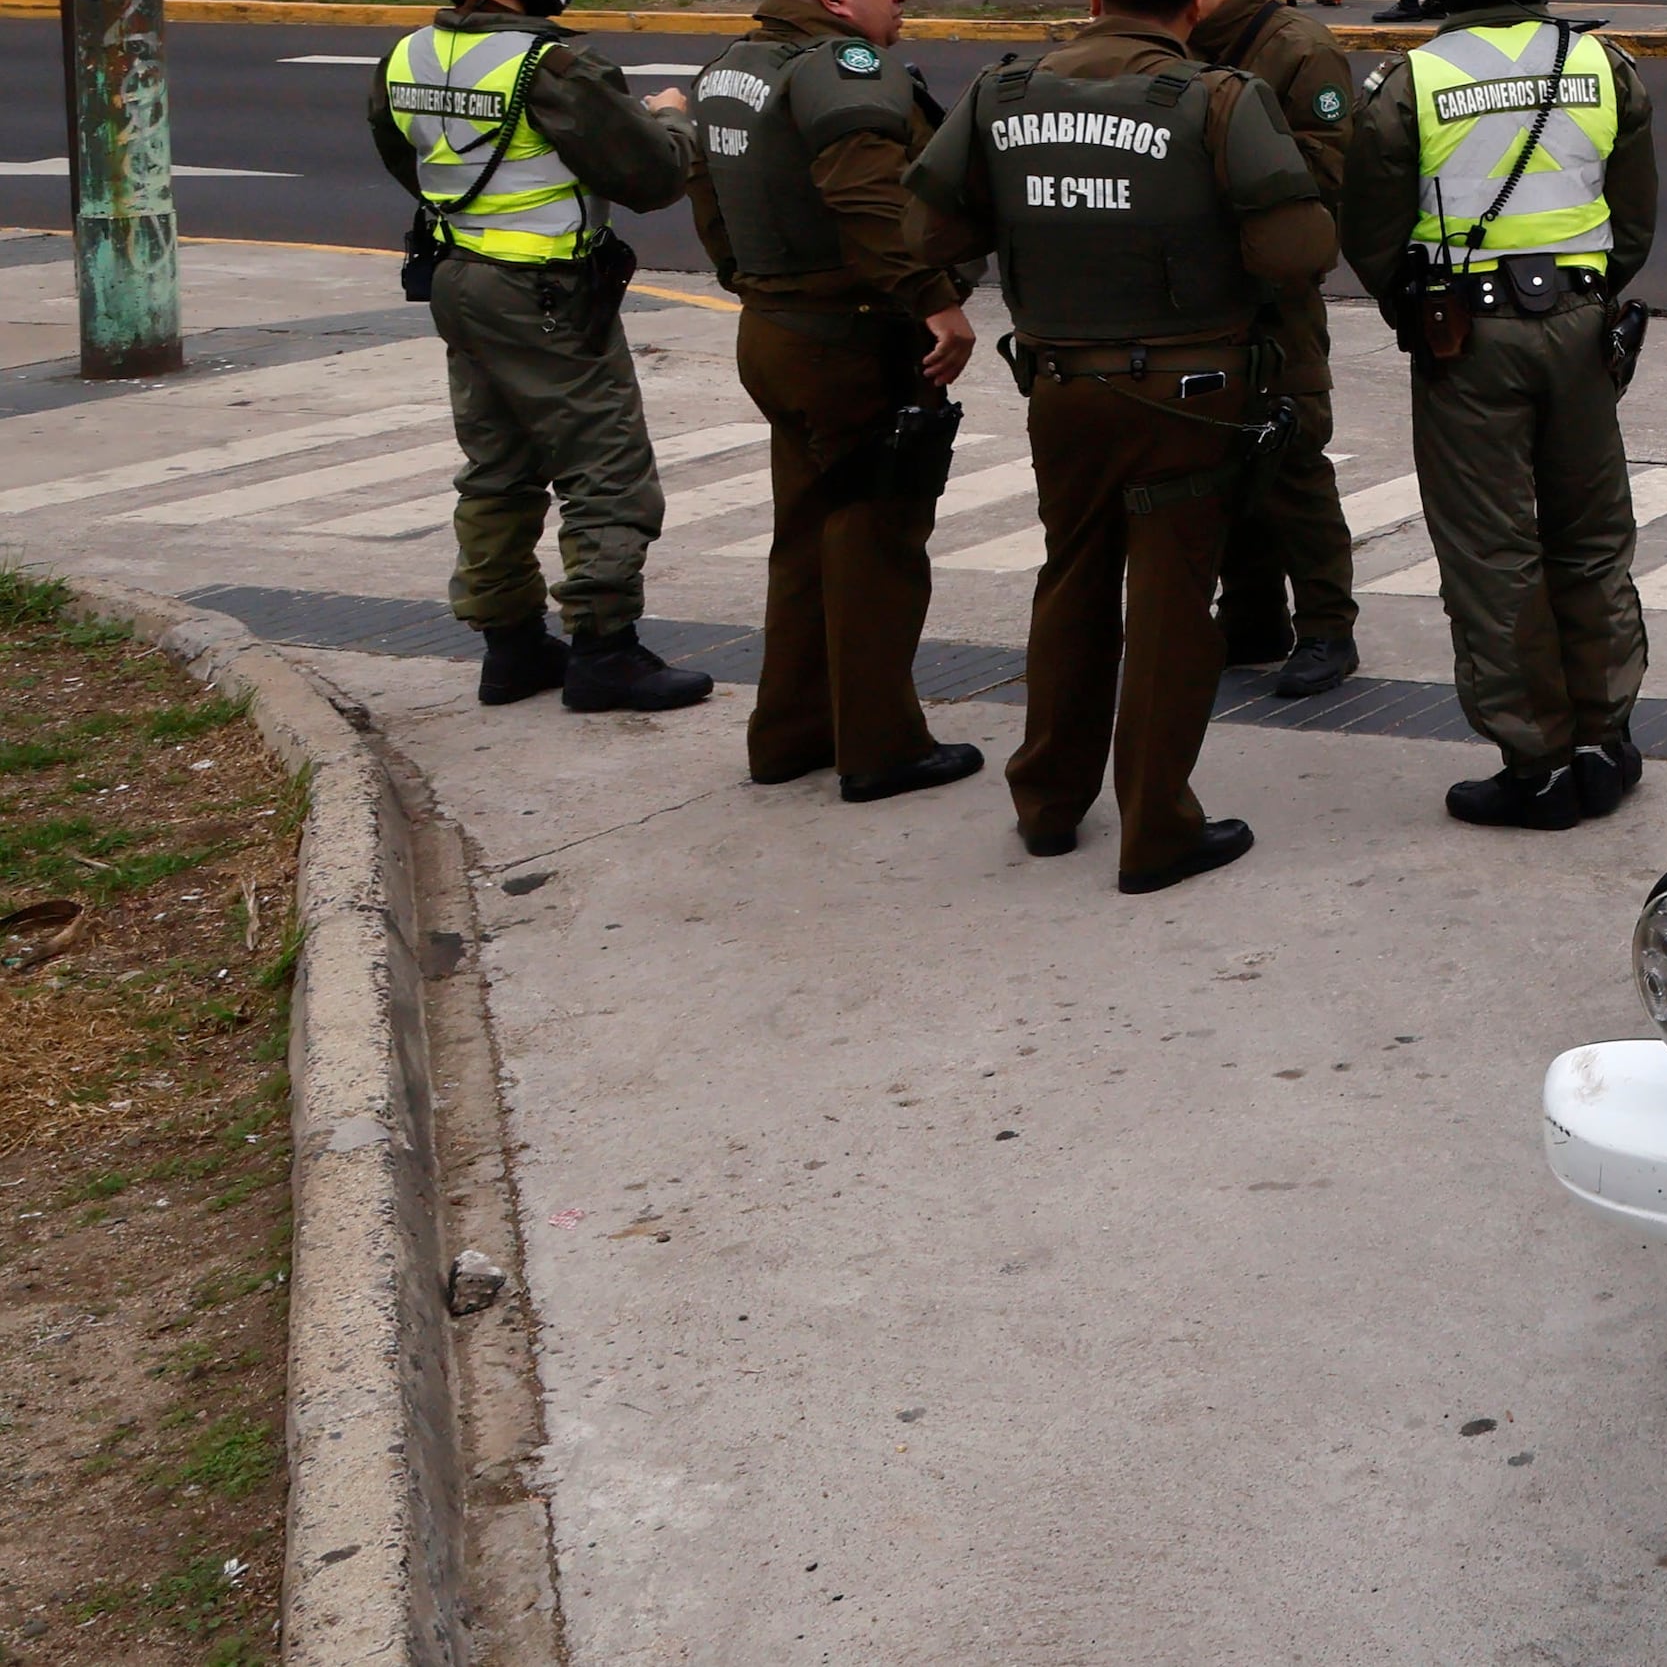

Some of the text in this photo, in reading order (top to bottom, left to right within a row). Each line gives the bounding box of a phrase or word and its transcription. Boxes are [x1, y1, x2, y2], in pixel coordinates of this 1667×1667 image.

[391, 85, 503, 118] CARABINEROS DE CHILE
[698, 69, 770, 113] CARABINEROS
[1437, 80, 1534, 120] CARABINEROS
[1559, 78, 1598, 103] CHILE
[708, 124, 749, 157] DE CHILE
[991, 112, 1171, 160] CARABINEROS
[1026, 175, 1132, 210] DE CHILE
